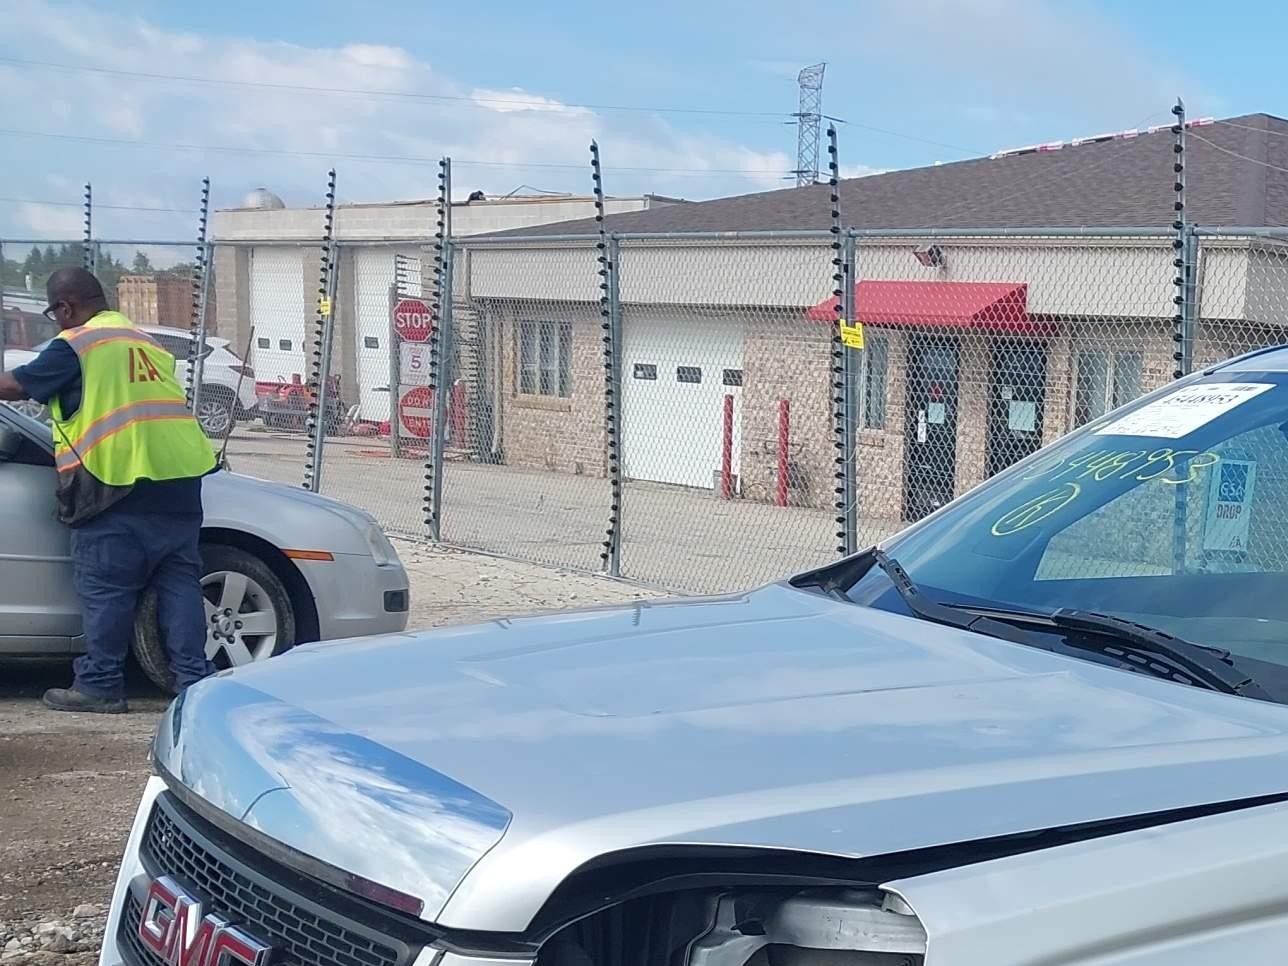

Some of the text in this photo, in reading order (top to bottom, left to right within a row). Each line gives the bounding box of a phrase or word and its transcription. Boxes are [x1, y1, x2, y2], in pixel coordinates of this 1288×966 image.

[397, 312, 430, 328] STOP
[411, 355, 421, 369] 5
[1216, 503, 1242, 519] DROP
